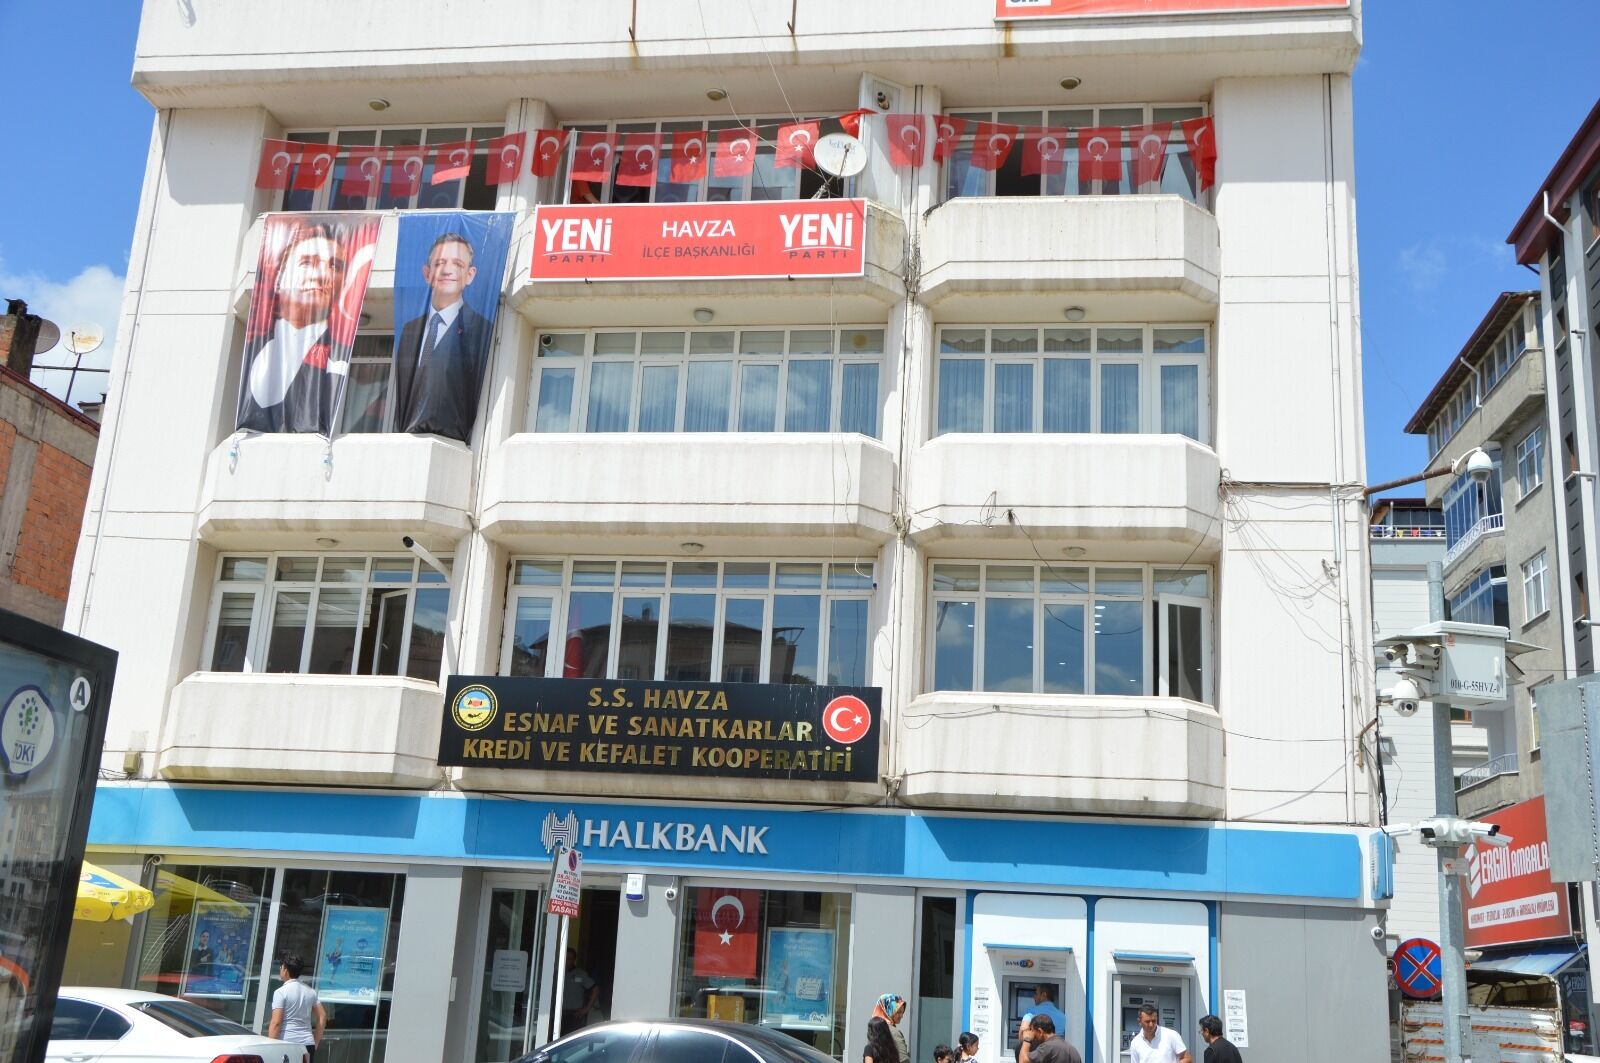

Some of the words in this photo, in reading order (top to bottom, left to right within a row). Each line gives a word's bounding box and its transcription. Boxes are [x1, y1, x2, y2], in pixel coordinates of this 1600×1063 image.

[661, 219, 736, 238] HAVZA
[642, 244, 671, 260] İLÇE
[674, 242, 755, 260] BAŞKANLIĞI
[73, 681, 86, 706] A
[587, 687, 635, 708] S.S.
[643, 688, 729, 711] HAVZA
[503, 712, 580, 733] ESNAF
[588, 714, 619, 736] VE
[627, 716, 813, 742] SANATKARLAR
[463, 736, 532, 760] KREDİ
[541, 741, 571, 762] VE
[579, 742, 683, 766] KEFALET
[692, 745, 852, 772] KOOPERATİFİ
[582, 819, 770, 855] HALKBANK
[1511, 841, 1550, 877] AMBALA
